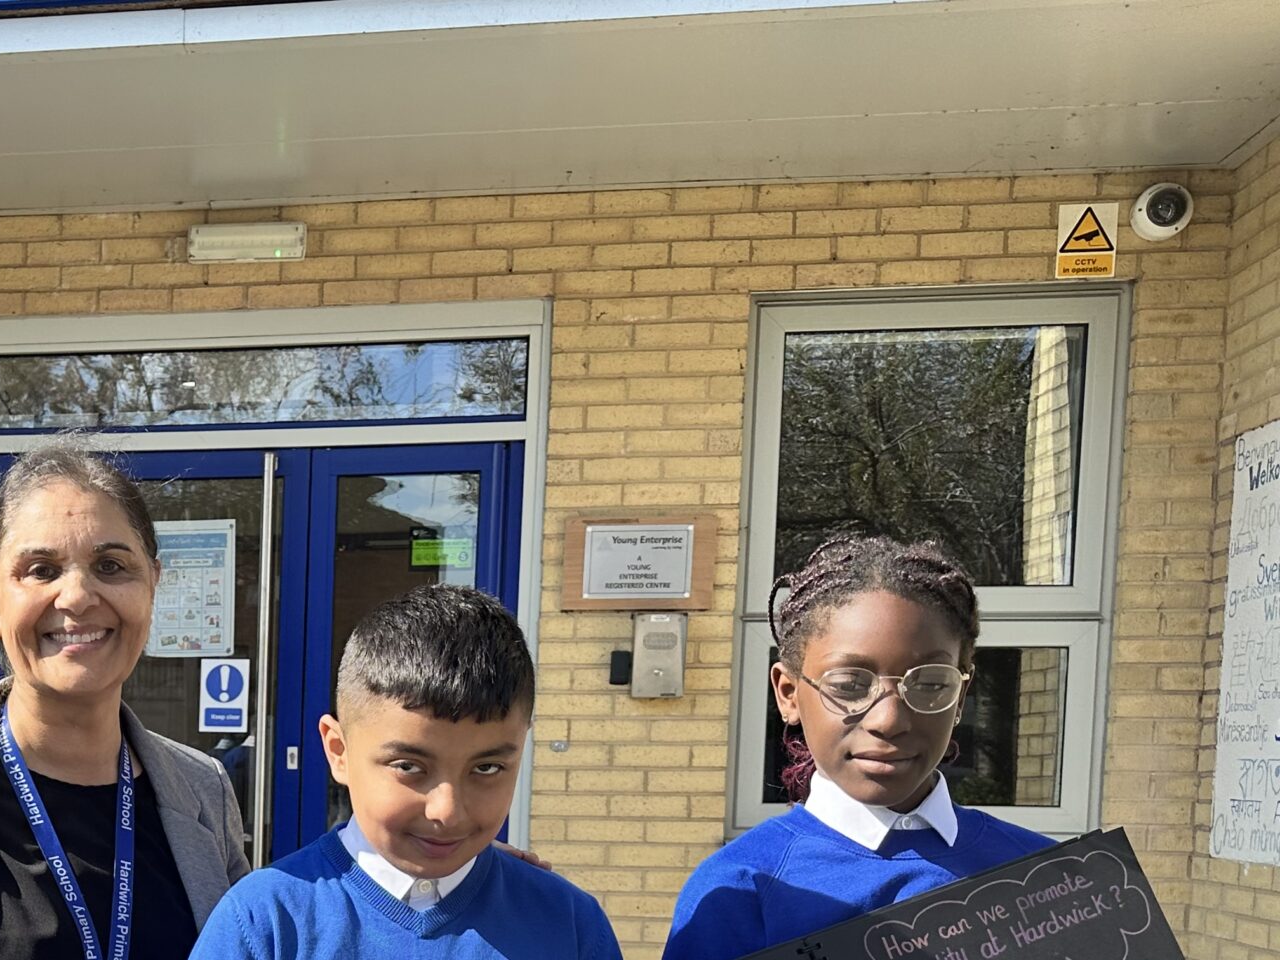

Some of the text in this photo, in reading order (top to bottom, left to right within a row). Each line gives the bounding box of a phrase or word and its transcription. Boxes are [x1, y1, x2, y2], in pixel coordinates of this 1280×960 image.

[1072, 266, 1107, 274] operation
[611, 535, 683, 546] Young Enterprise
[627, 563, 651, 571] YOUNG
[9, 763, 44, 826] Hardwick
[121, 787, 133, 831] School
[48, 855, 97, 960] Primary School
[118, 859, 132, 921] Hardwick
[882, 932, 930, 960] How
[938, 917, 972, 940] can
[1016, 872, 1094, 925] promote
[980, 929, 1007, 959] at
